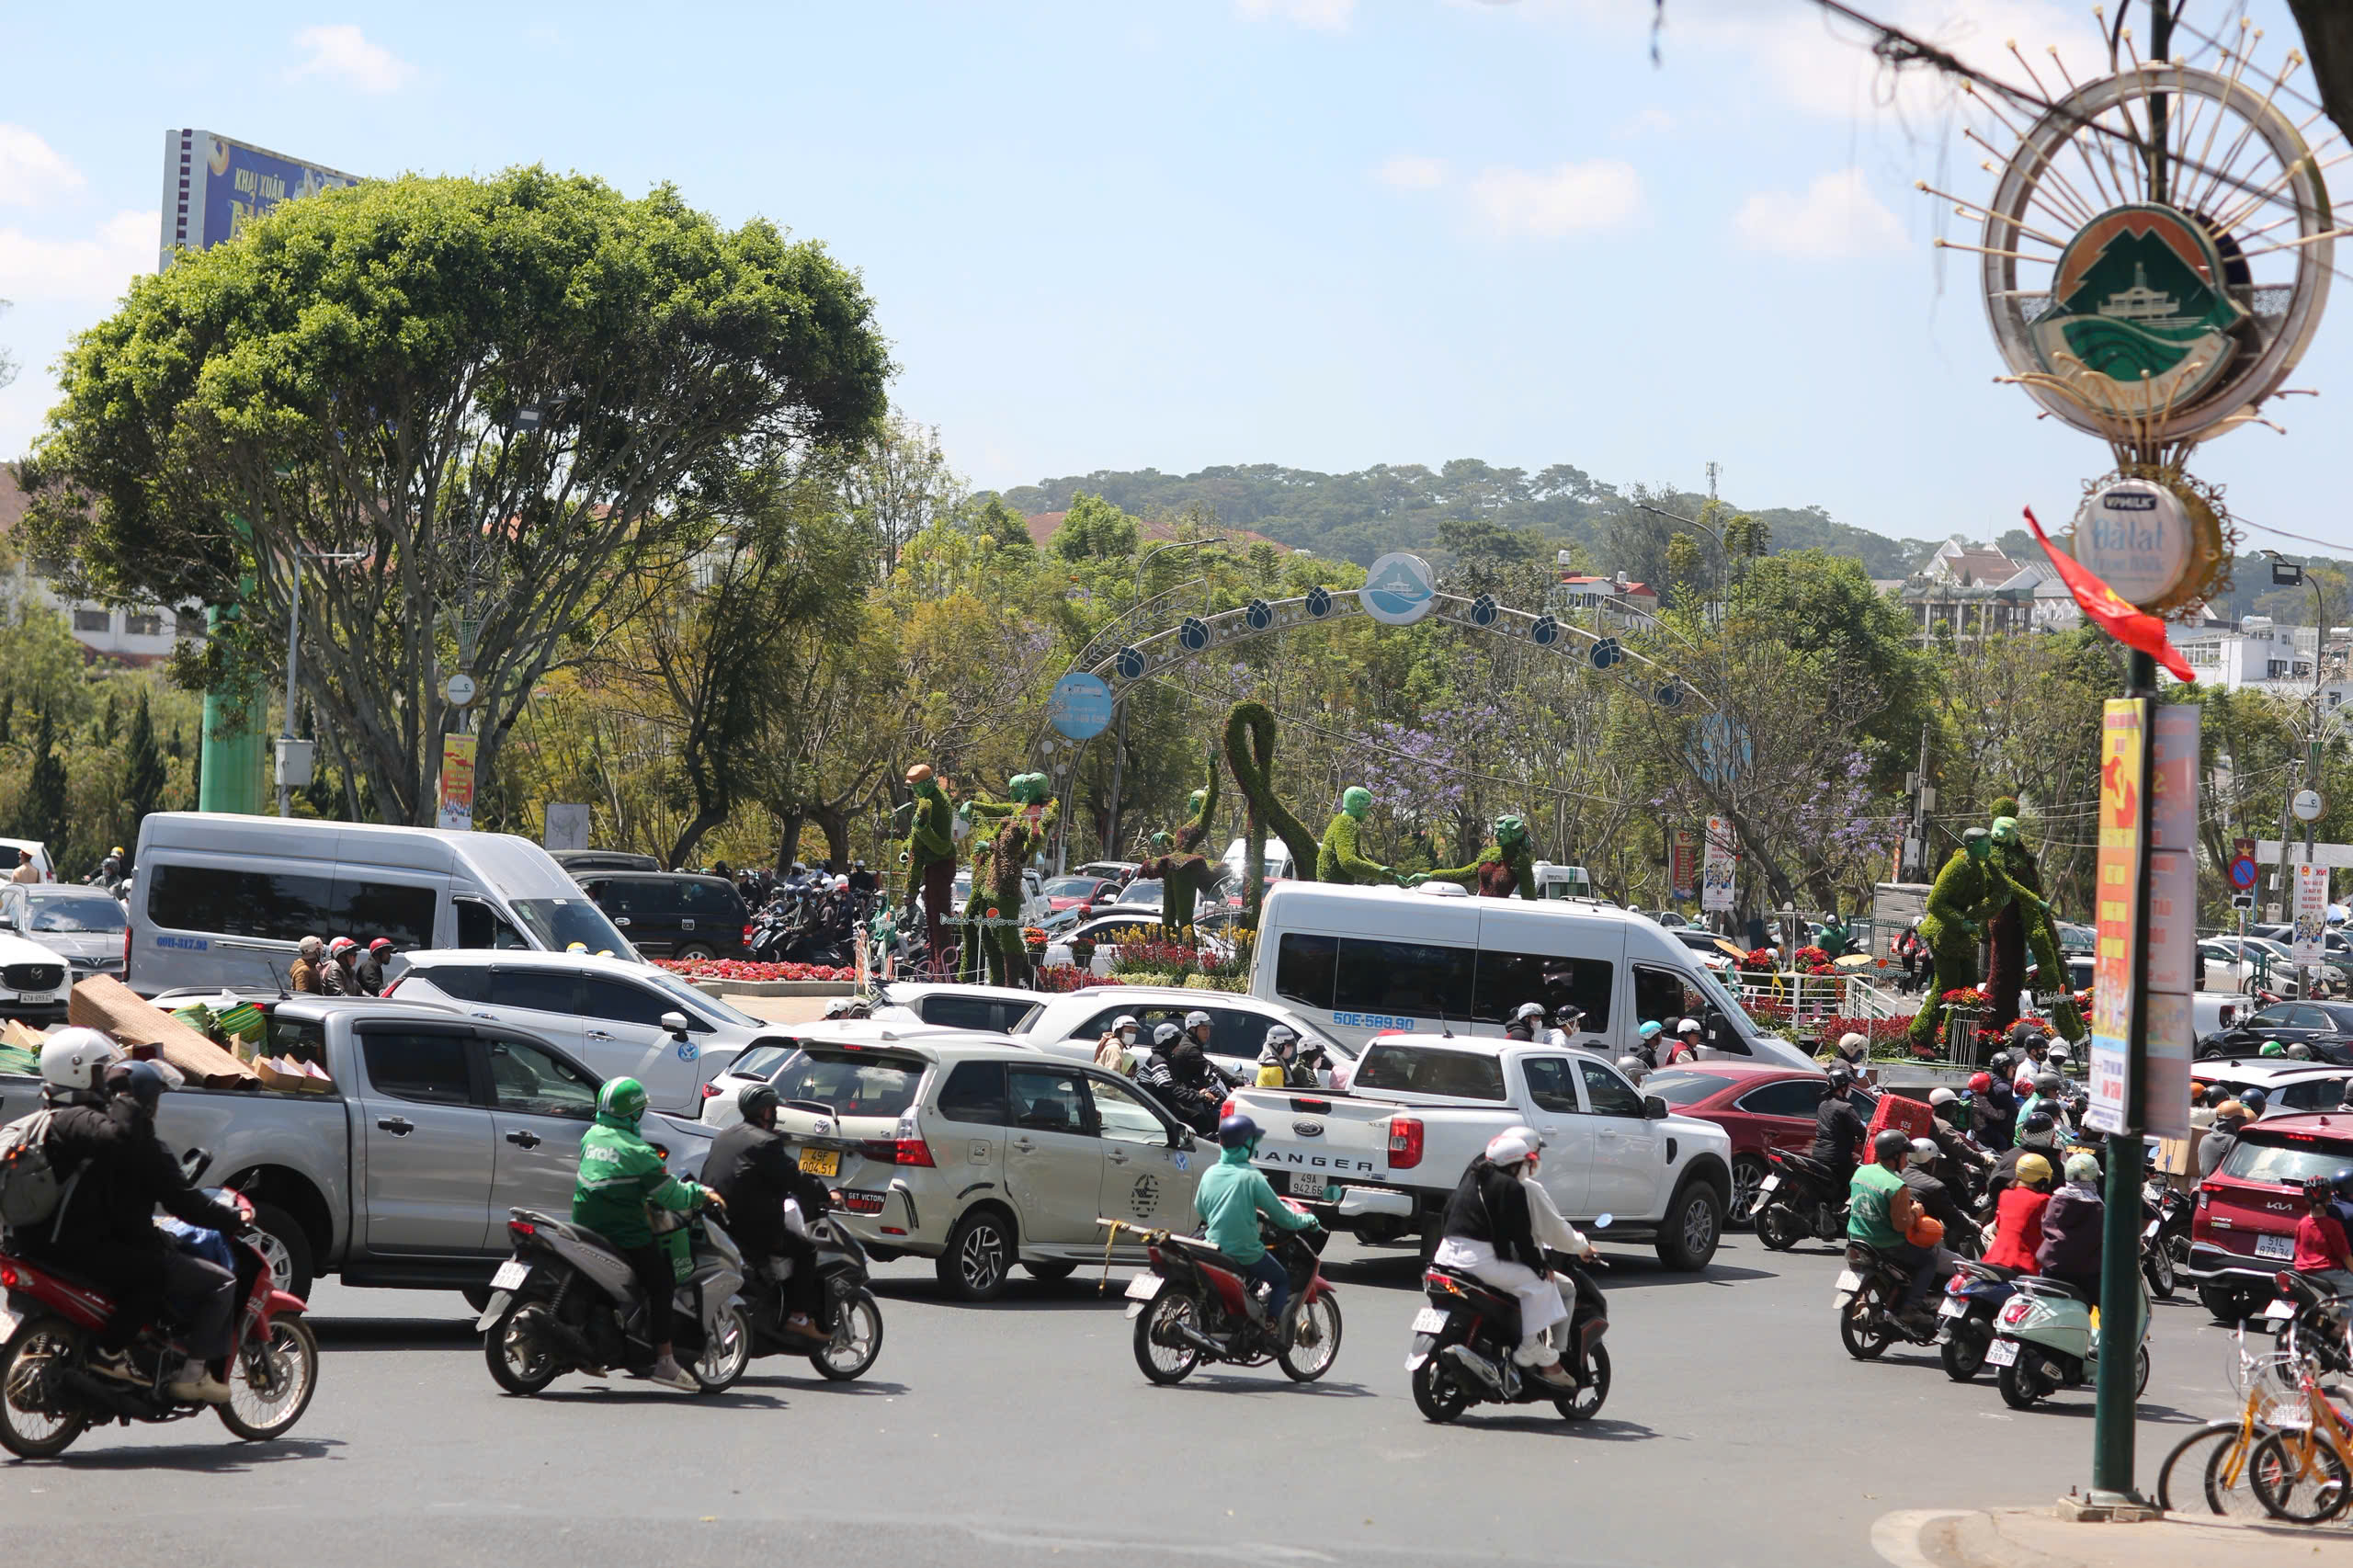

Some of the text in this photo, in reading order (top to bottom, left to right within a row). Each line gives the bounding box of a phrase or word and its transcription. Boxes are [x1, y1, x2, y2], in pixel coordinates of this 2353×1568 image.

[1333, 1012, 1415, 1030] 50E-589.90
[585, 1142, 620, 1164] Grab
[811, 1151, 829, 1161] 49F
[801, 1161, 833, 1176] 004.51
[1301, 1173, 1316, 1184] 49A
[1293, 1184, 1324, 1195] 942.66
